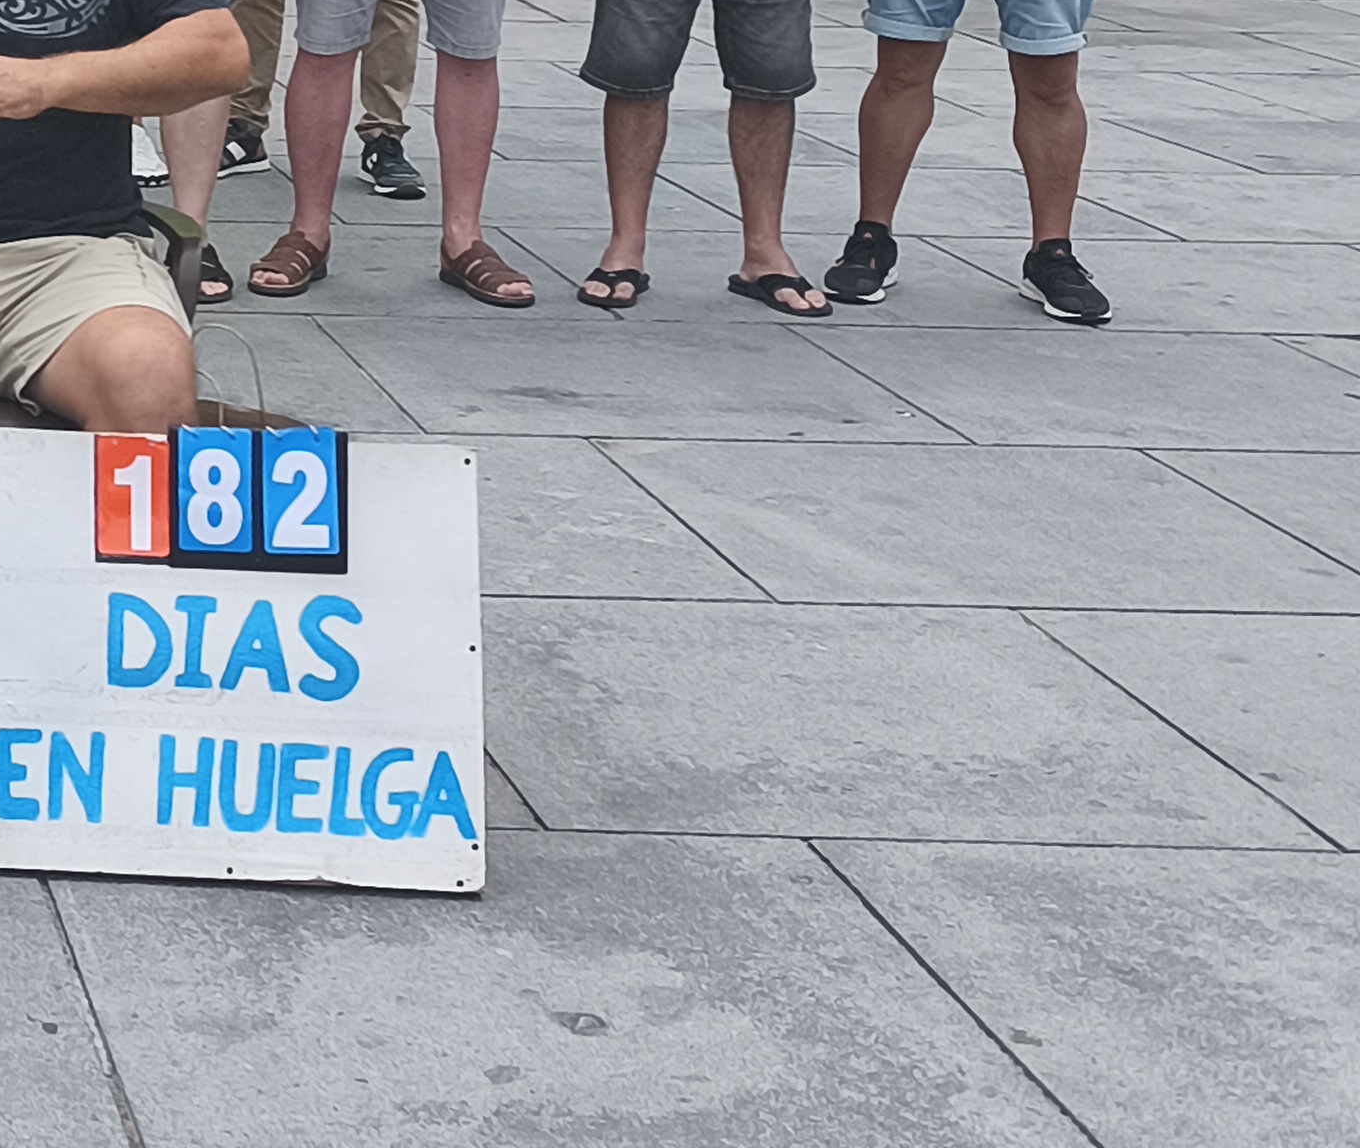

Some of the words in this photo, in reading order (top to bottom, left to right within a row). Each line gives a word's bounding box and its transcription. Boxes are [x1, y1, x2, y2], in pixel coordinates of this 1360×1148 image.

[113, 449, 330, 552] 182
[108, 592, 363, 702] DIAS
[157, 733, 478, 841] HUELGA
